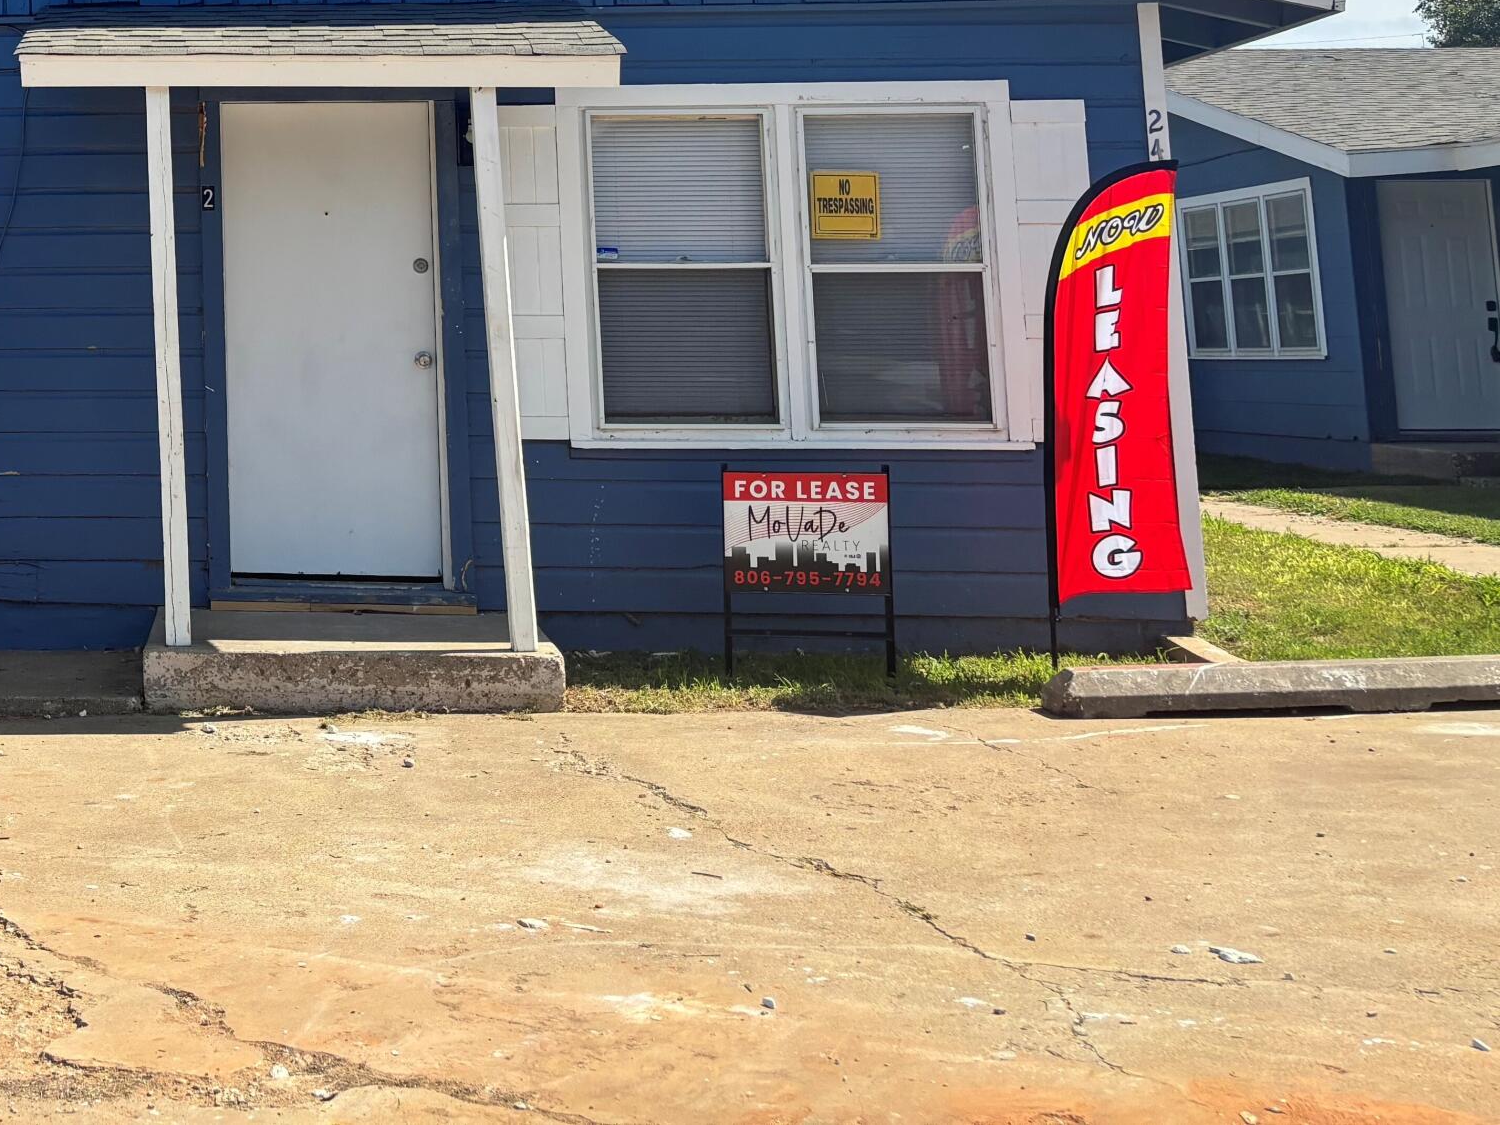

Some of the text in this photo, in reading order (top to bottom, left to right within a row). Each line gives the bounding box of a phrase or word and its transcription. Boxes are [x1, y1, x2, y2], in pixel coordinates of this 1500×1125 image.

[838, 178, 851, 196] NO
[203, 188, 214, 208] 2
[816, 197, 875, 215] TRESPASSING
[1074, 202, 1165, 260] NOW
[1084, 263, 1143, 580] LEASING
[734, 480, 876, 500] FOR LEASE
[801, 539, 861, 552] REALTY
[734, 570, 882, 588] 806-795-7794
